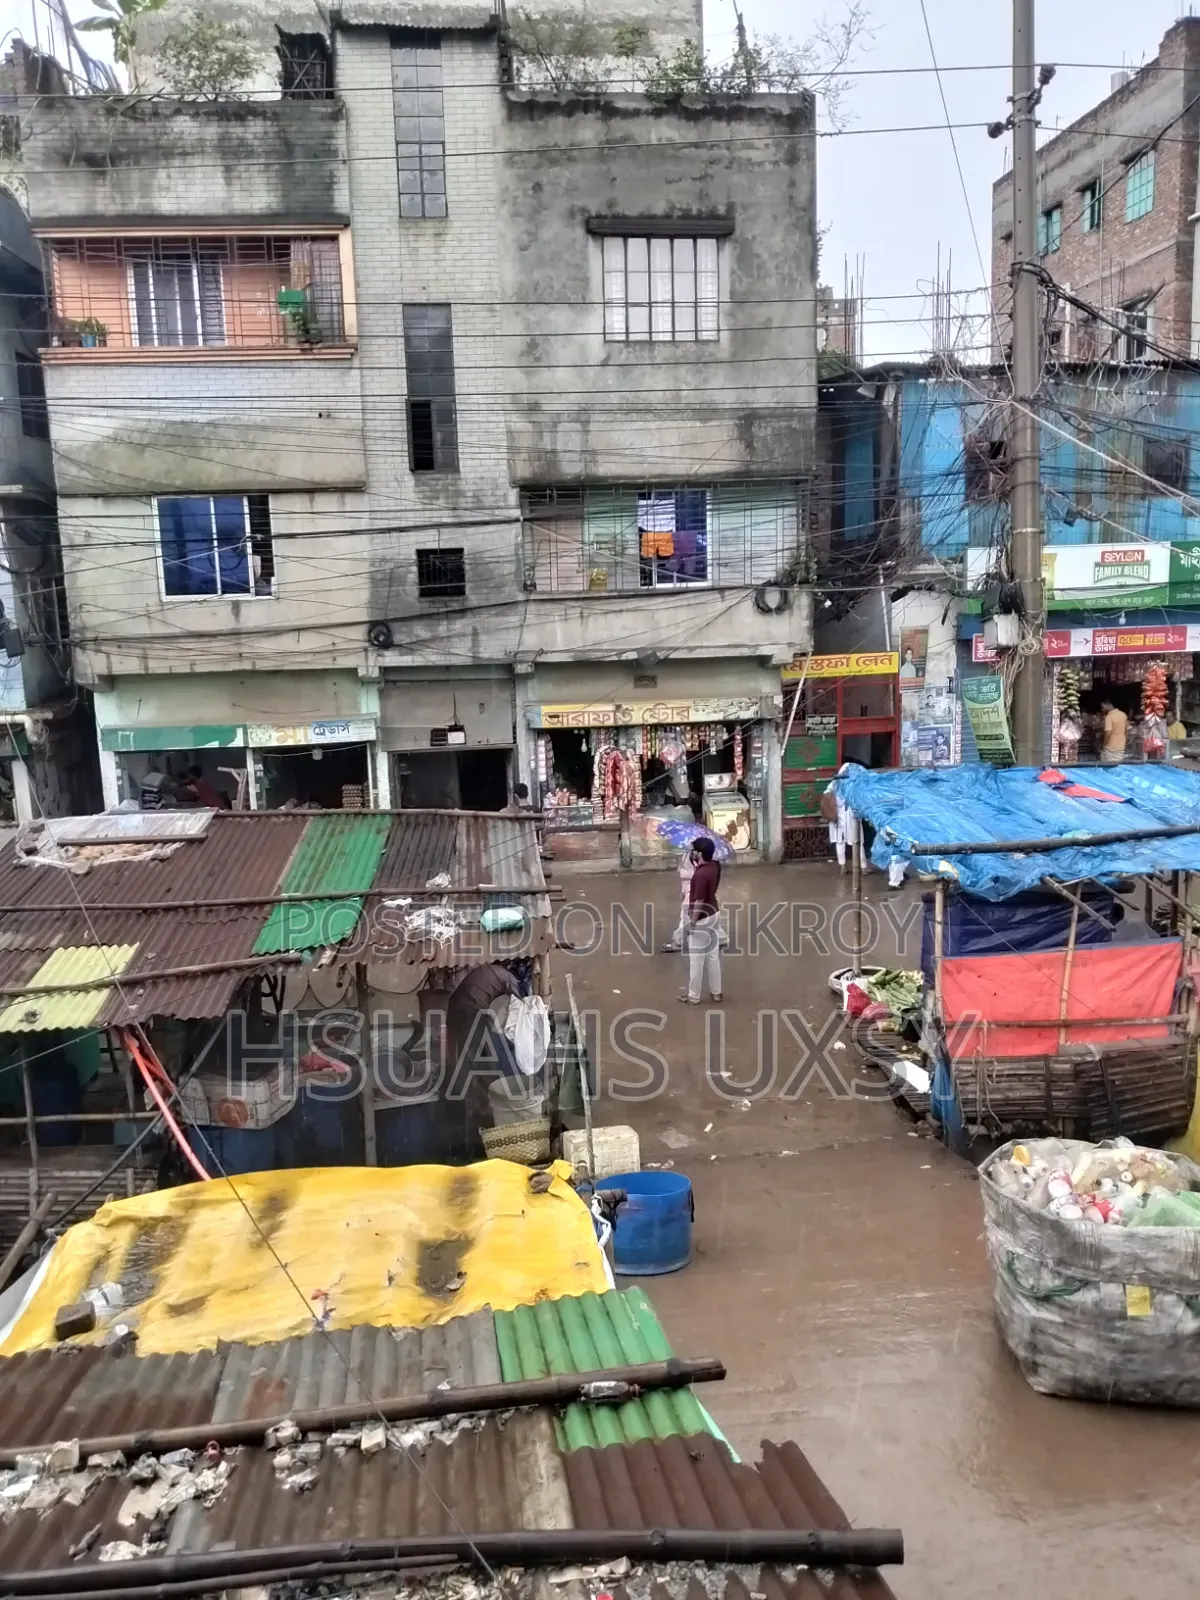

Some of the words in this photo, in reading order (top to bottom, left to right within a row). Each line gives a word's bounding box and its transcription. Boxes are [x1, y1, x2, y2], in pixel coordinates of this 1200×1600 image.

[1104, 552, 1142, 563] SEYLON
[1094, 566, 1123, 581] FAMILY
[1123, 565, 1149, 580] BLEND
[856, 654, 892, 667] লেন
[313, 721, 351, 735] ট্রেডার্স
